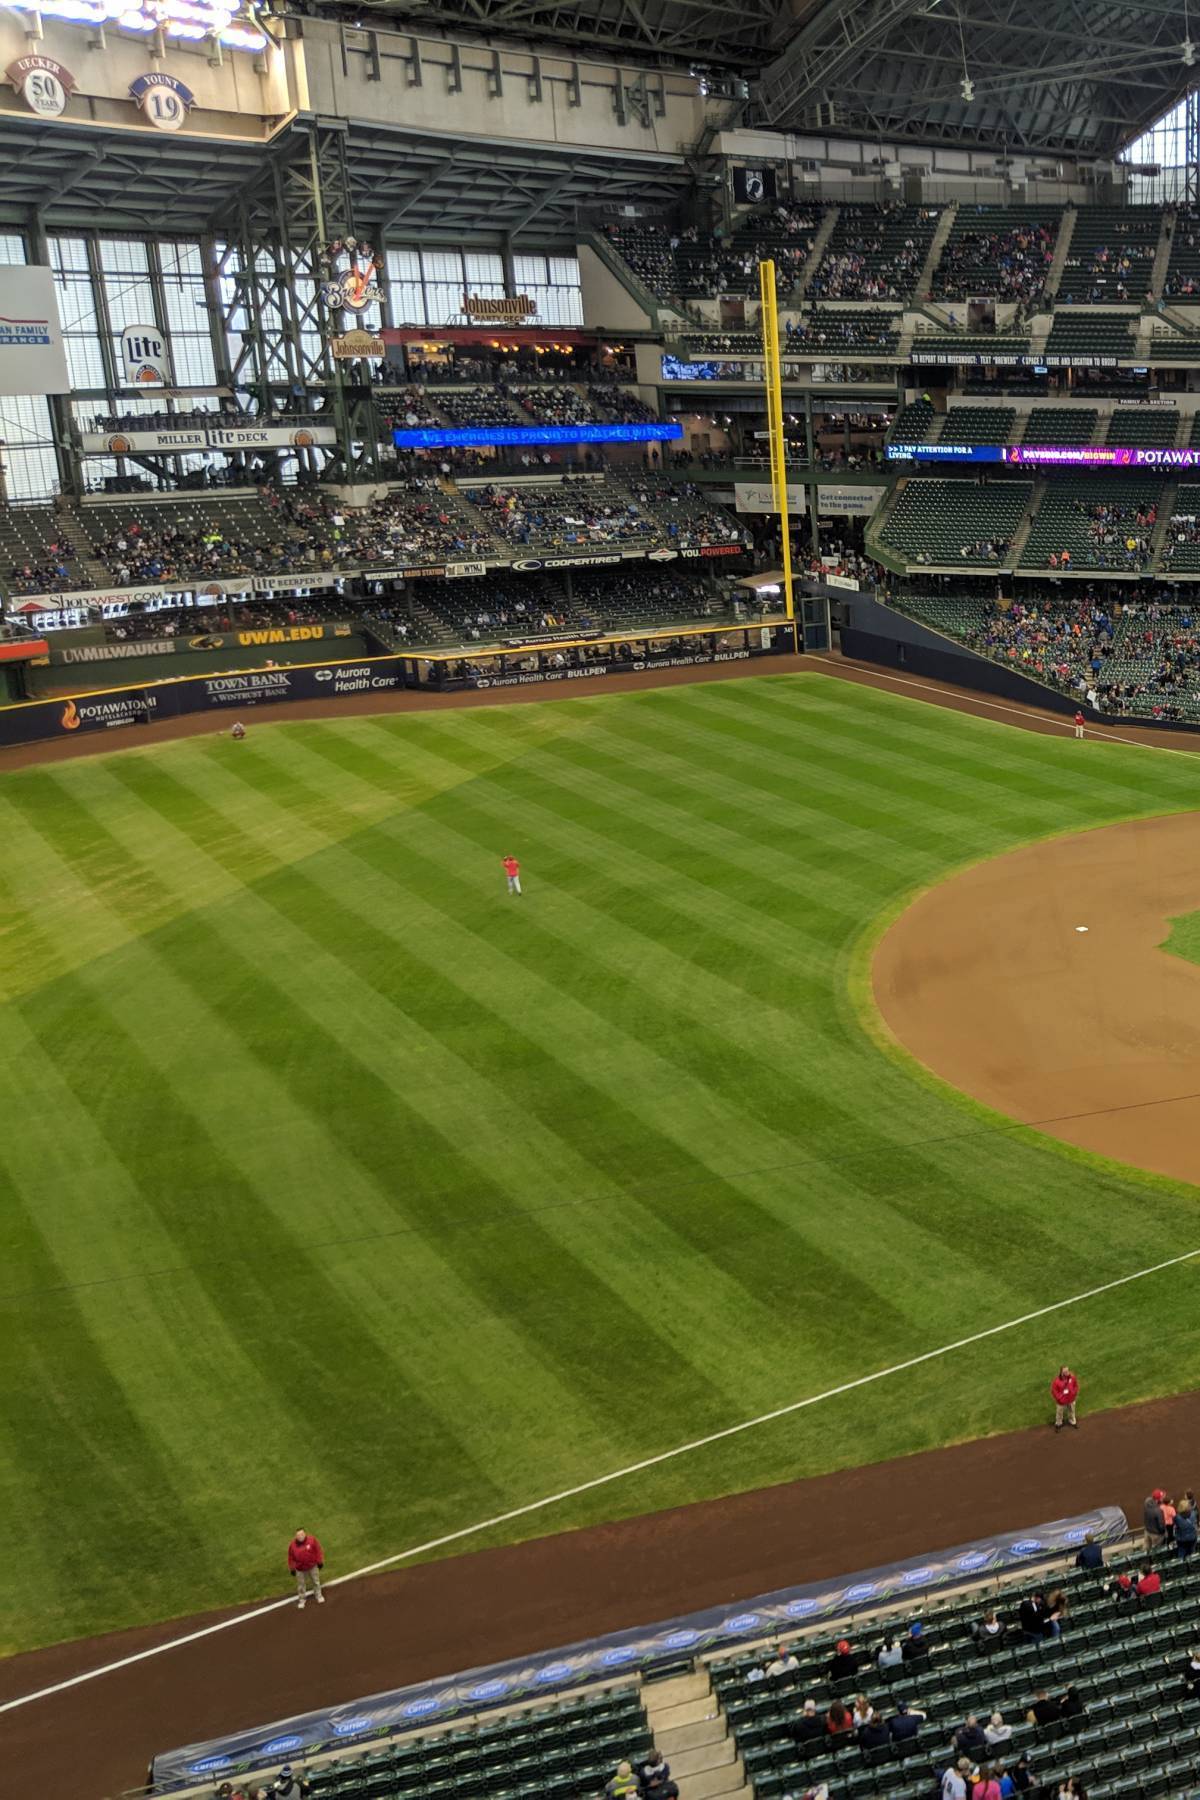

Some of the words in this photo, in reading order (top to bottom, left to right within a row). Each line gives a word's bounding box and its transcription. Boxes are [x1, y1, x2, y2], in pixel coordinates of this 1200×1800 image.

[18, 57, 60, 75] UECKER
[31, 75, 57, 98] 50
[143, 75, 179, 90] YOUNT
[151, 94, 180, 122] 19
[461, 293, 537, 315] Johnsonville
[473, 315, 500, 323] PARTY
[16, 325, 48, 336] FAMILY
[126, 336, 162, 363] Lite
[335, 340, 384, 356] Johnsonville
[157, 435, 202, 445] MILLER
[204, 430, 234, 448] Lite
[237, 432, 268, 443] DECK
[421, 567, 445, 577] STATION
[238, 626, 324, 646] UWM.EDU
[647, 657, 670, 669] Aurora
[671, 654, 693, 666] Health
[694, 654, 710, 663] Care
[714, 650, 750, 661] BULLPEN
[335, 668, 371, 679] Aurora
[492, 675, 518, 686] Aurora
[519, 673, 544, 682] Health
[545, 672, 562, 680] Care
[567, 666, 607, 678] BULLPEN
[205, 676, 250, 692] TOWN
[251, 672, 291, 687] BANK
[335, 679, 370, 692] Health
[371, 676, 397, 688] Care
[218, 690, 262, 702] WINTRUST
[264, 687, 288, 696] BANK
